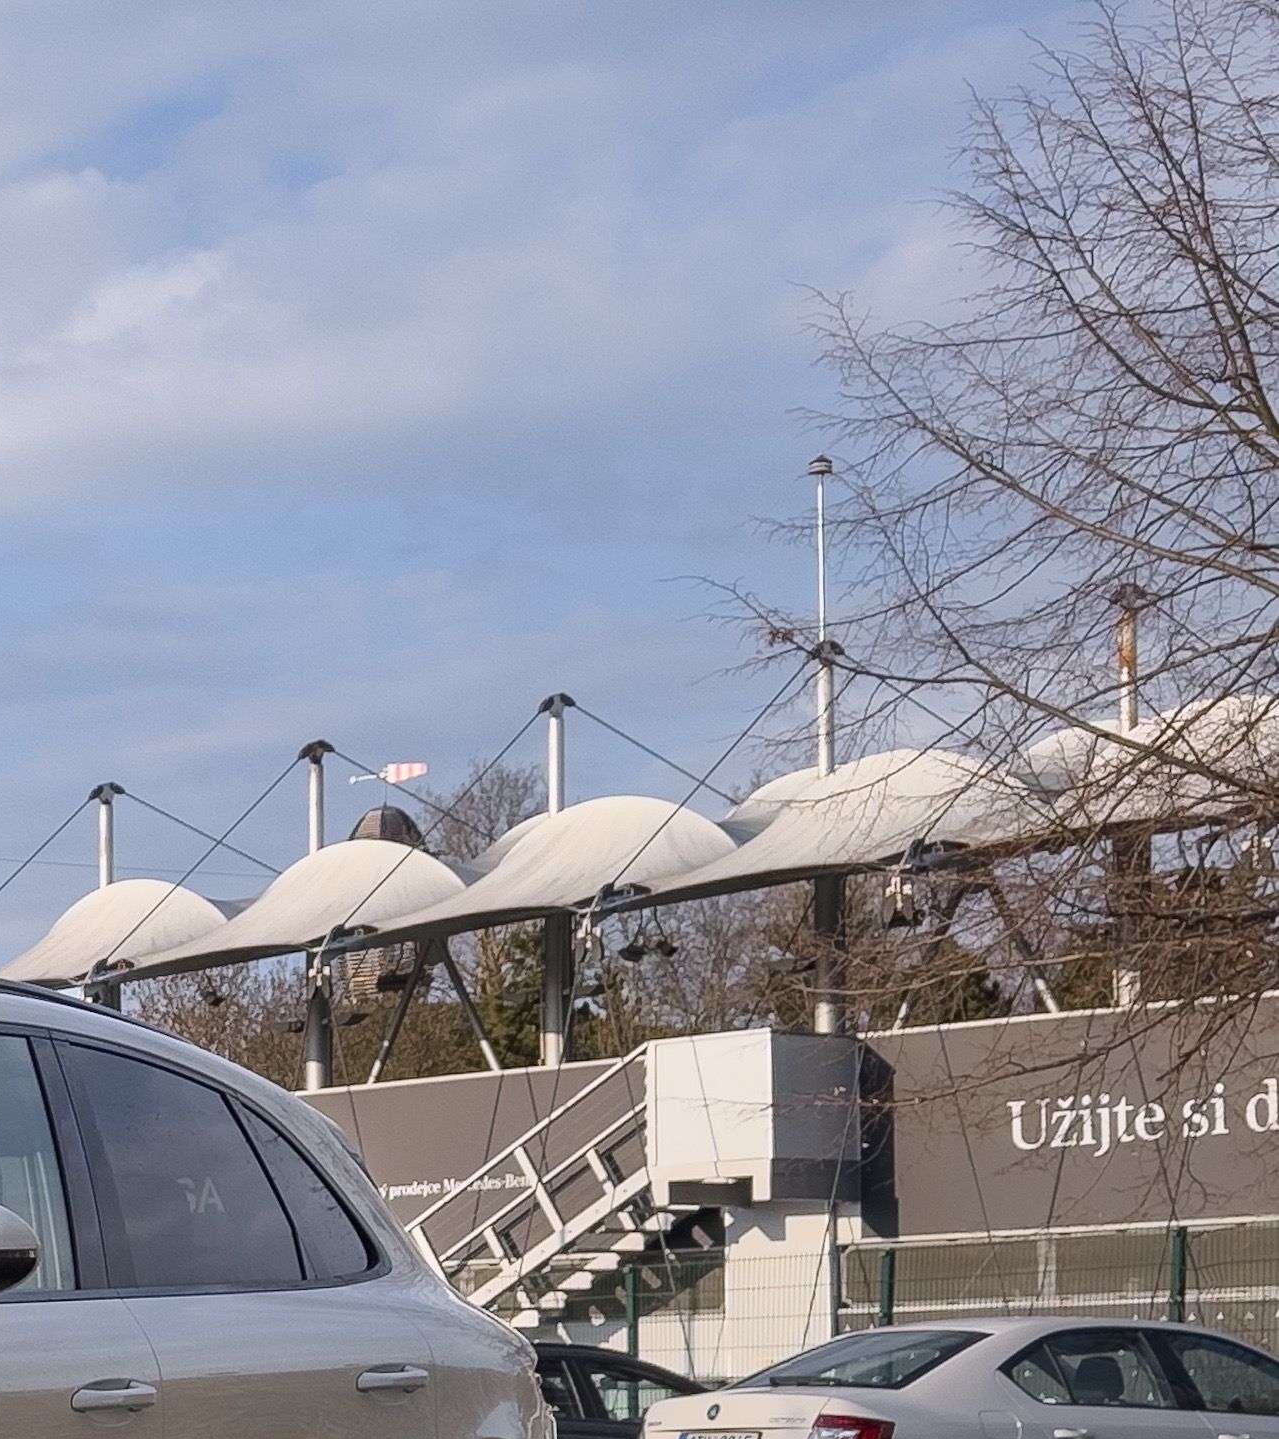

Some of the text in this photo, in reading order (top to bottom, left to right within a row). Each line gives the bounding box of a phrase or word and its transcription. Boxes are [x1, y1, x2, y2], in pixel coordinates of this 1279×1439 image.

[1006, 1092, 1166, 1158] Užijte
[1182, 1082, 1240, 1138] si
[389, 1180, 441, 1200] prodejce
